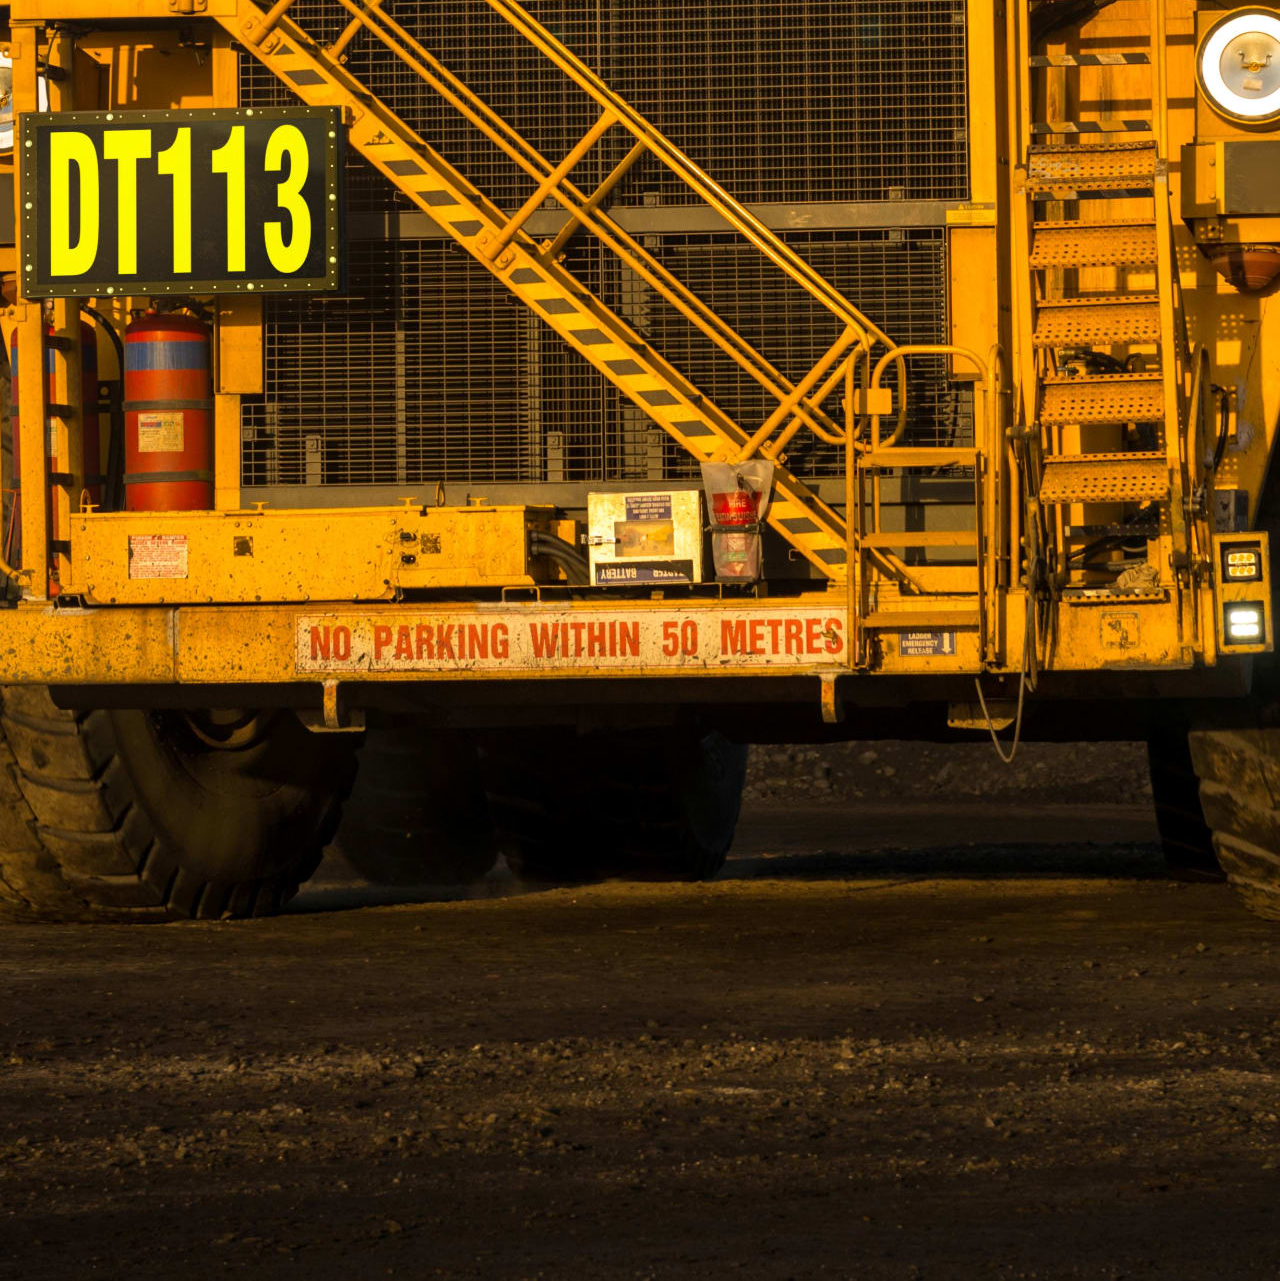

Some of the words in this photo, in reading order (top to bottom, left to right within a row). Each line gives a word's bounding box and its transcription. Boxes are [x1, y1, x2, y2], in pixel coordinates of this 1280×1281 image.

[50, 124, 312, 276] DT113
[601, 568, 637, 580] BATTERY
[310, 625, 351, 661] NO
[374, 623, 509, 660] PARKING
[529, 620, 640, 658] WITHIN
[662, 619, 699, 657] 50
[720, 617, 844, 655] METRES
